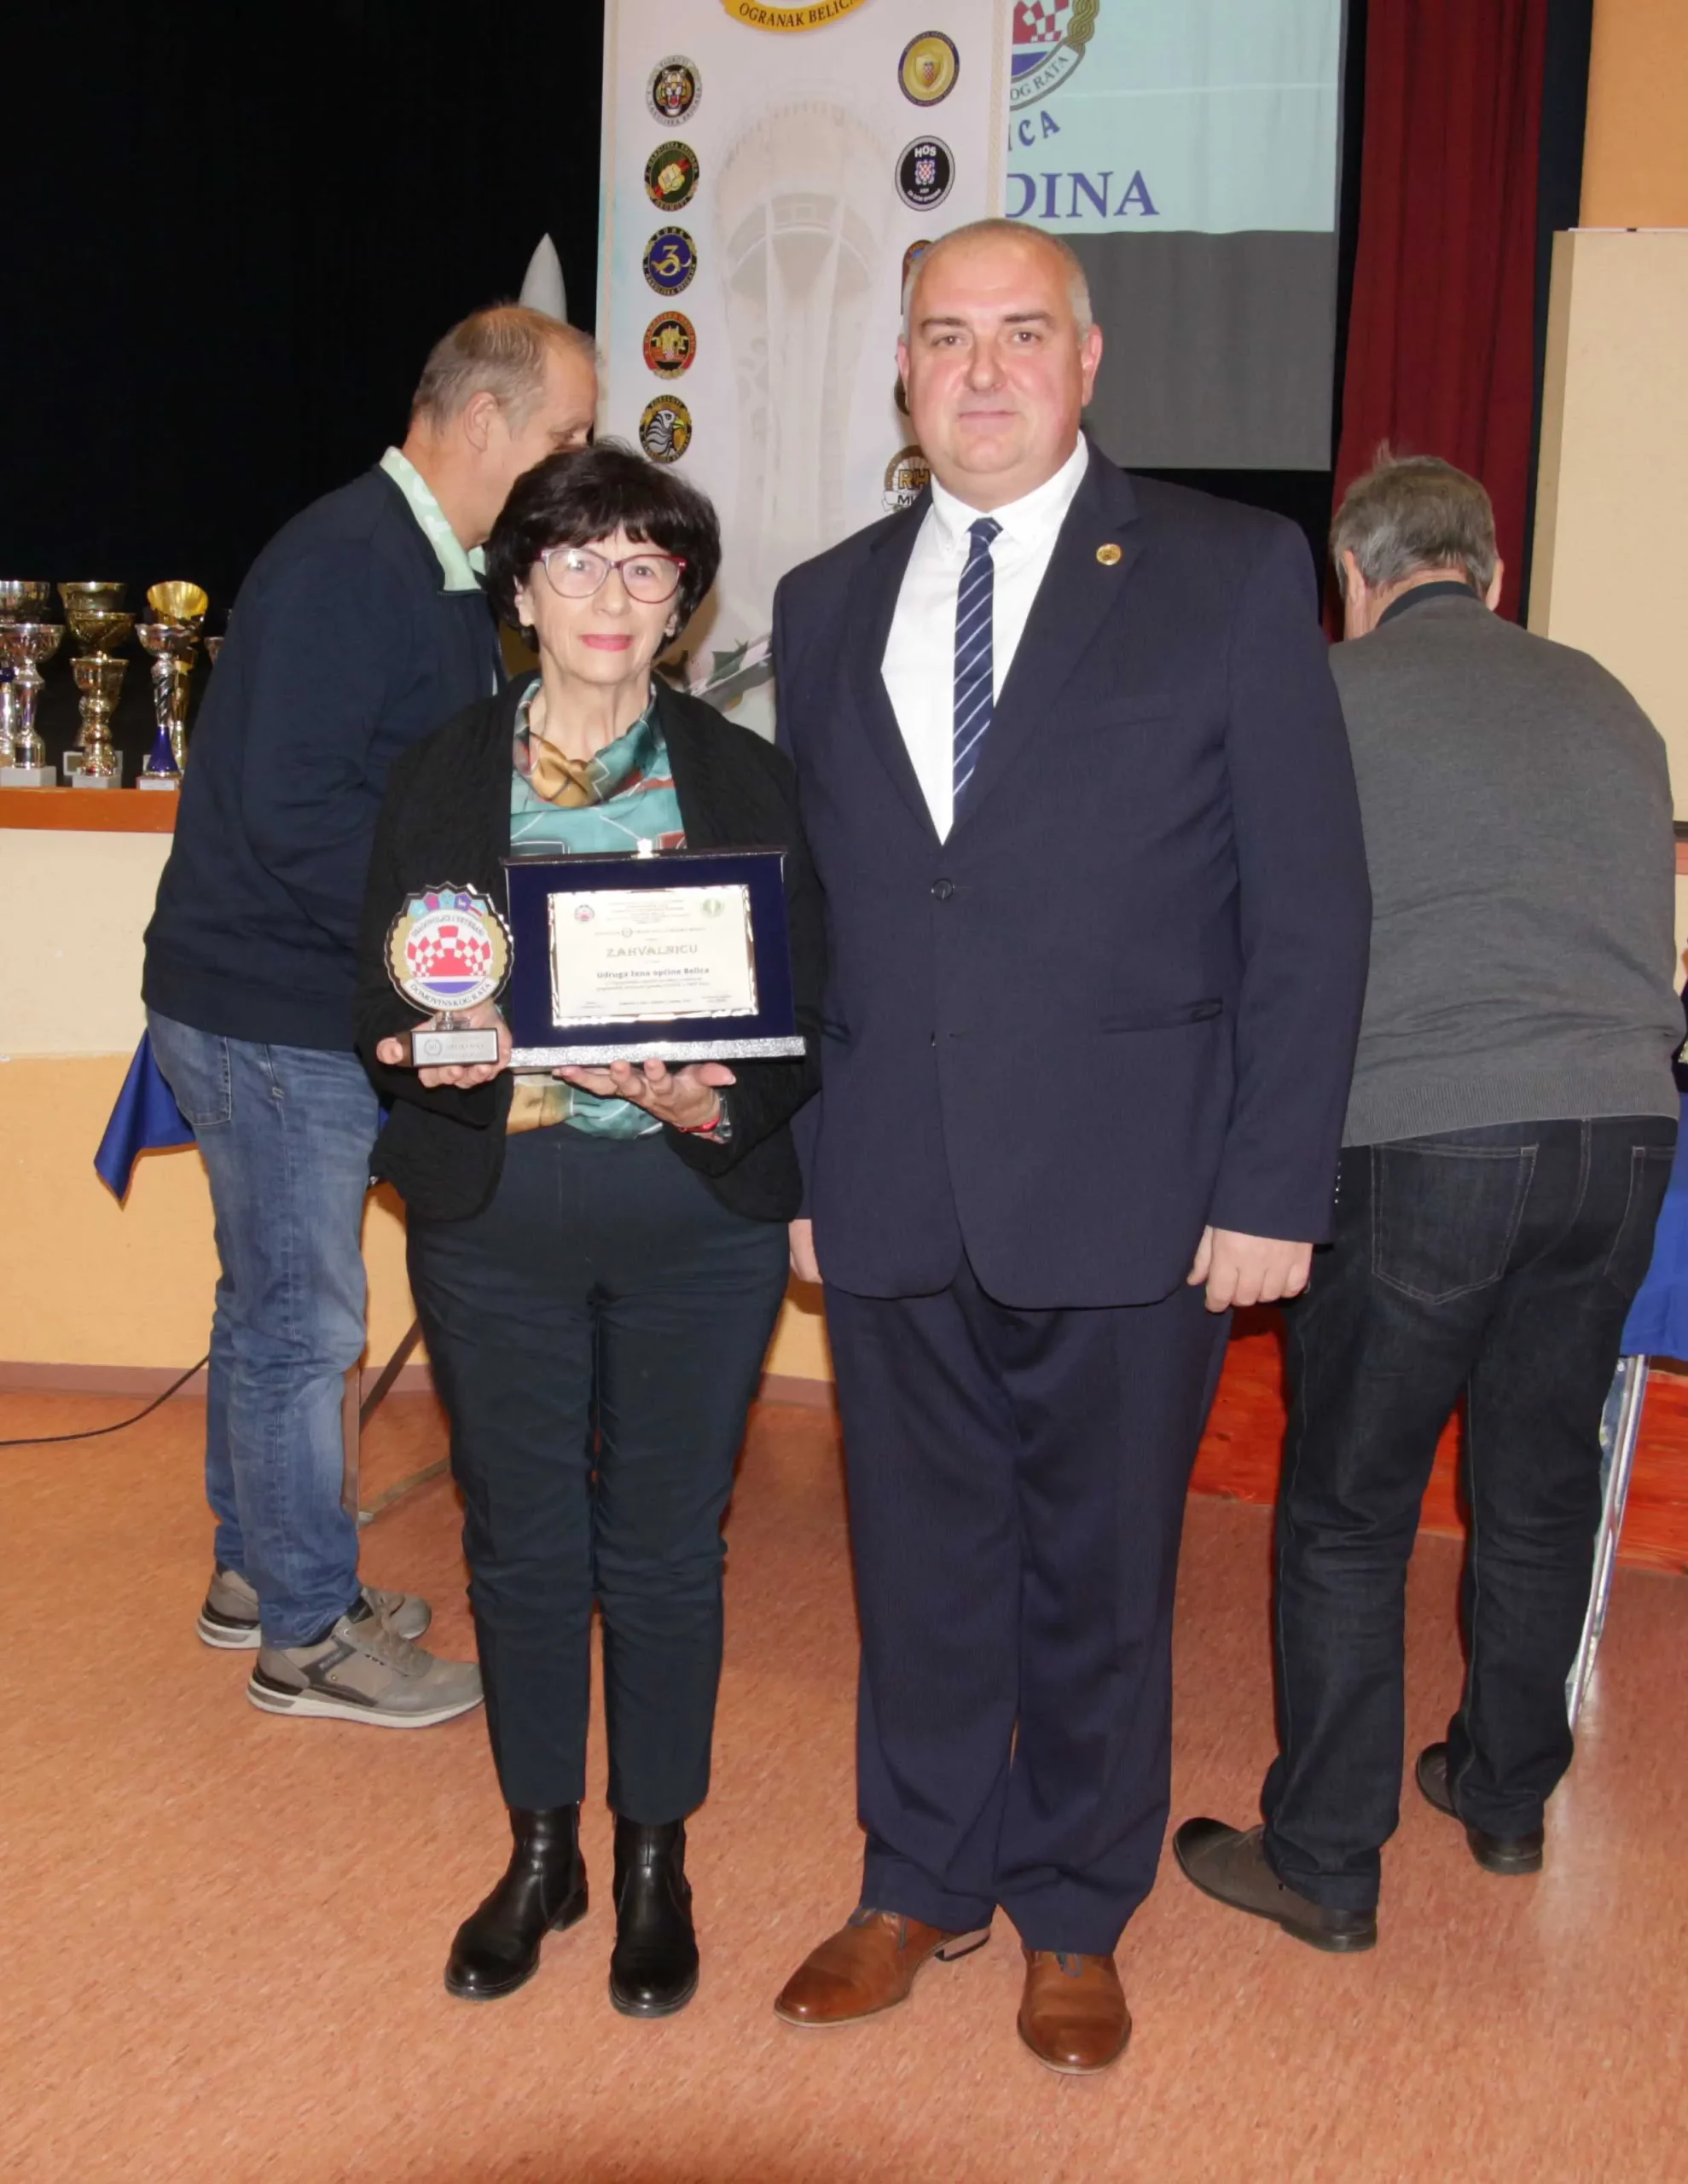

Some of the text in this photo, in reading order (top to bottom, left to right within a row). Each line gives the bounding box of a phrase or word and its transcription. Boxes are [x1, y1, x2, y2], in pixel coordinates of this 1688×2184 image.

[740, 3, 804, 27] OGRANAK
[1033, 55, 1069, 90] RATA
[914, 145, 937, 157] HOS
[410, 984, 471, 1007] DOMOVINSKOG
